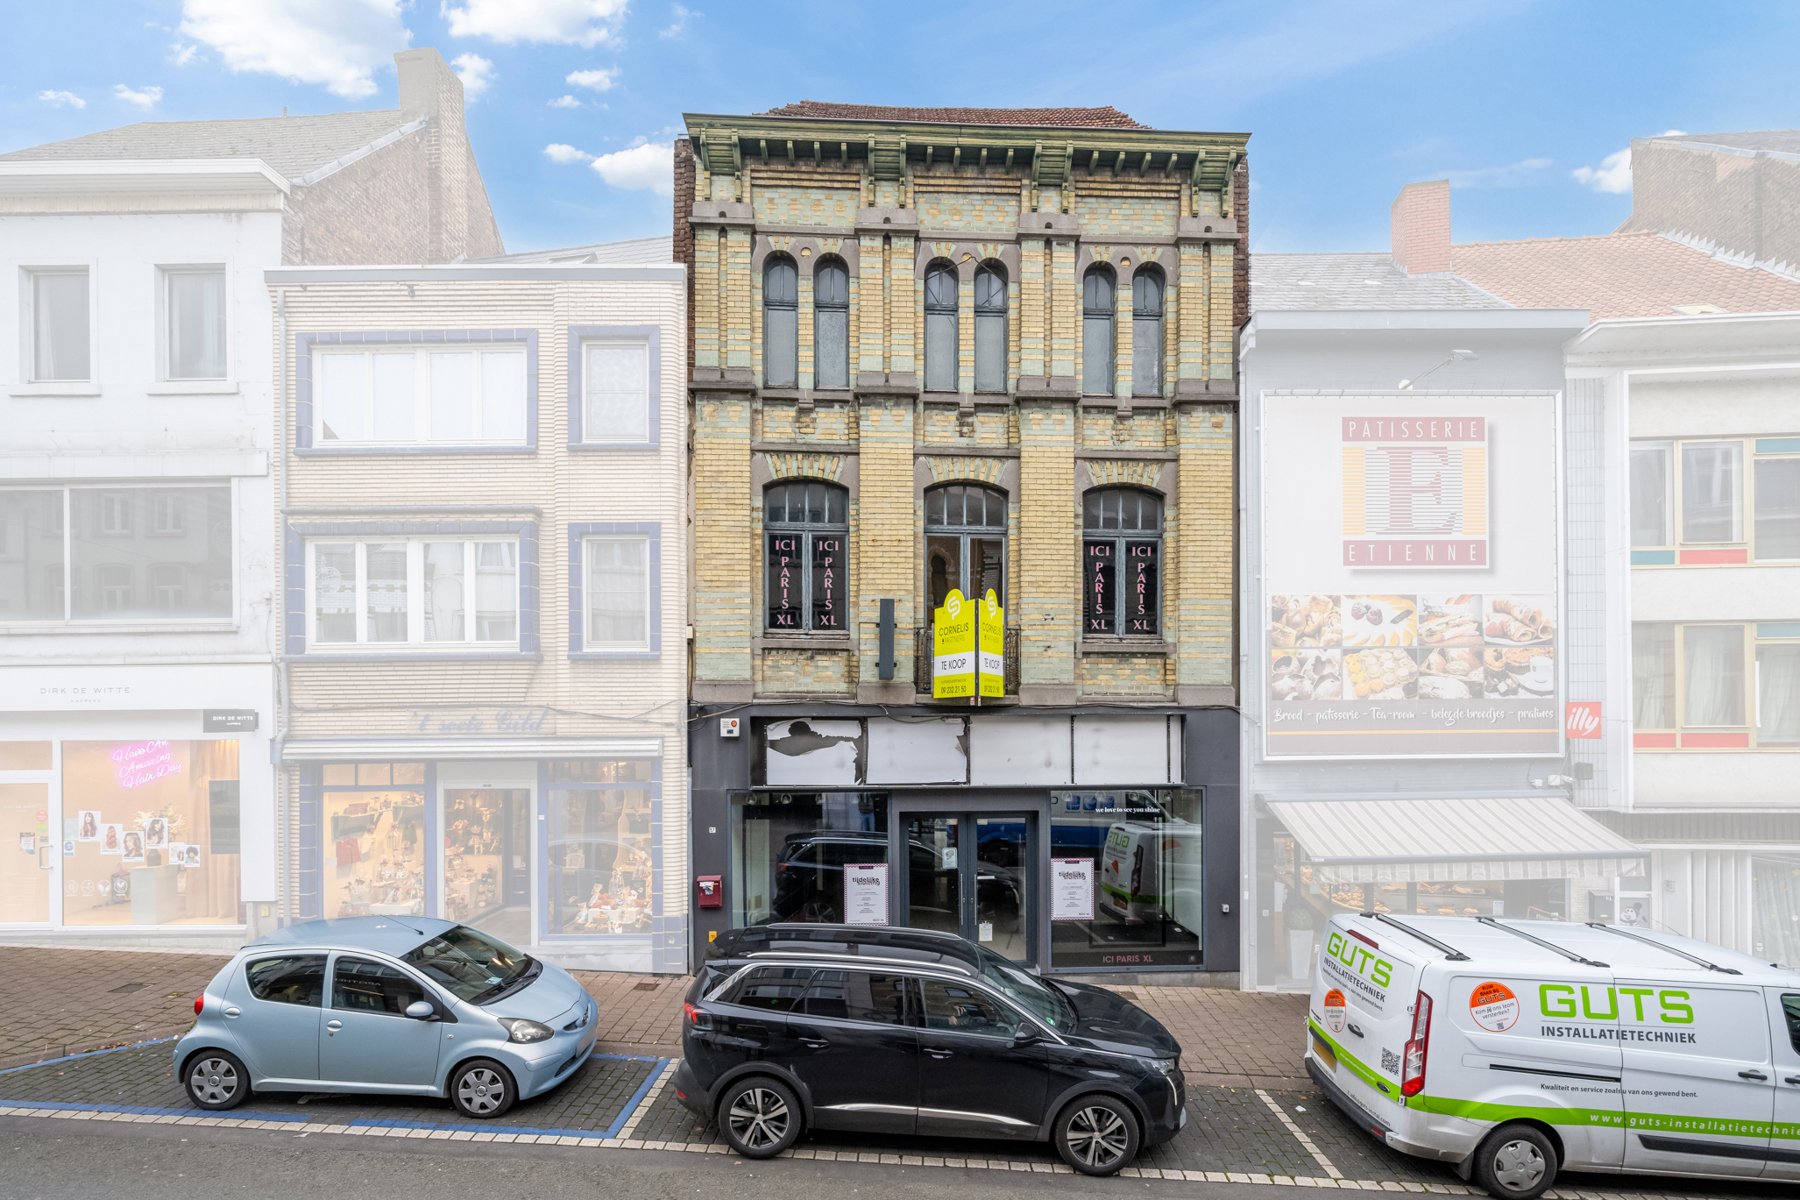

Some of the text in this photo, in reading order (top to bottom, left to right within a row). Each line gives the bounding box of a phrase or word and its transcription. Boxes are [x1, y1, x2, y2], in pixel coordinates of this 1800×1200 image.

[1349, 421, 1477, 438] PATISSERIE
[776, 540, 795, 551] ICI
[819, 541, 838, 551] ICI
[1090, 546, 1110, 556] ICI
[1132, 546, 1151, 557] ICI
[1349, 544, 1476, 561] ETIENNE
[780, 556, 790, 609] PARIS
[824, 557, 833, 610] PARIS
[1095, 562, 1104, 614] PARIS
[1137, 562, 1146, 614] PARIS
[777, 614, 794, 625] XL
[820, 615, 837, 625] XL
[1091, 620, 1108, 630] XL
[1133, 620, 1150, 630] XL
[938, 622, 969, 636] CORNELIS
[941, 658, 966, 670] TE KOOP
[1274, 708, 1303, 722] Brood
[1316, 708, 1360, 723] patisserie
[1369, 706, 1415, 720] Tea-room
[1431, 708, 1464, 726] belegde
[1467, 708, 1505, 724] broodjes
[1518, 707, 1554, 721] pralines
[1567, 706, 1599, 736] illy
[112, 746, 146, 762] Have
[119, 753, 170, 778] Amazing
[122, 764, 181, 788] Hair Day
[1327, 932, 1393, 988] GUTS
[1324, 957, 1386, 1002] INSTALLATIETECHNIEK
[1477, 992, 1506, 1004] GUTS
[1538, 984, 1694, 1024] GUTS
[1541, 1026, 1696, 1043] INSTALLATIETECHNIEK
